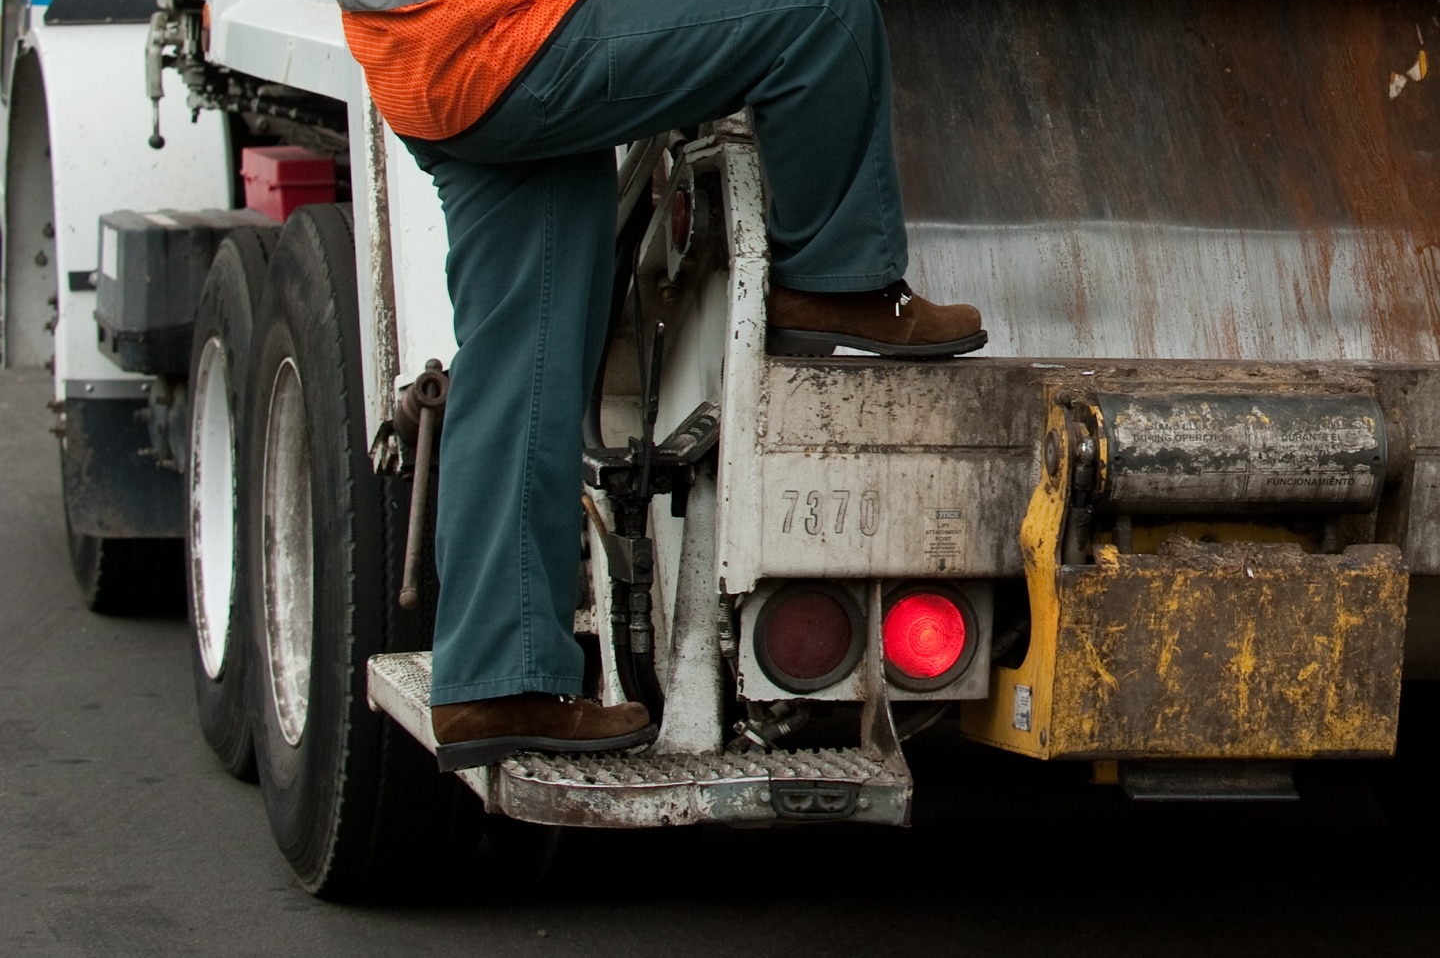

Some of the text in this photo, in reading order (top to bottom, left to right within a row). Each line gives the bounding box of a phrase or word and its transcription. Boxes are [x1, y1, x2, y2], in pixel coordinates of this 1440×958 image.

[1133, 433, 1231, 443] DURING OPERATION
[1281, 433, 1343, 442] DURANTE EL
[1266, 477, 1356, 486] FUNCIONAMIENTO
[781, 489, 882, 537] 7370
